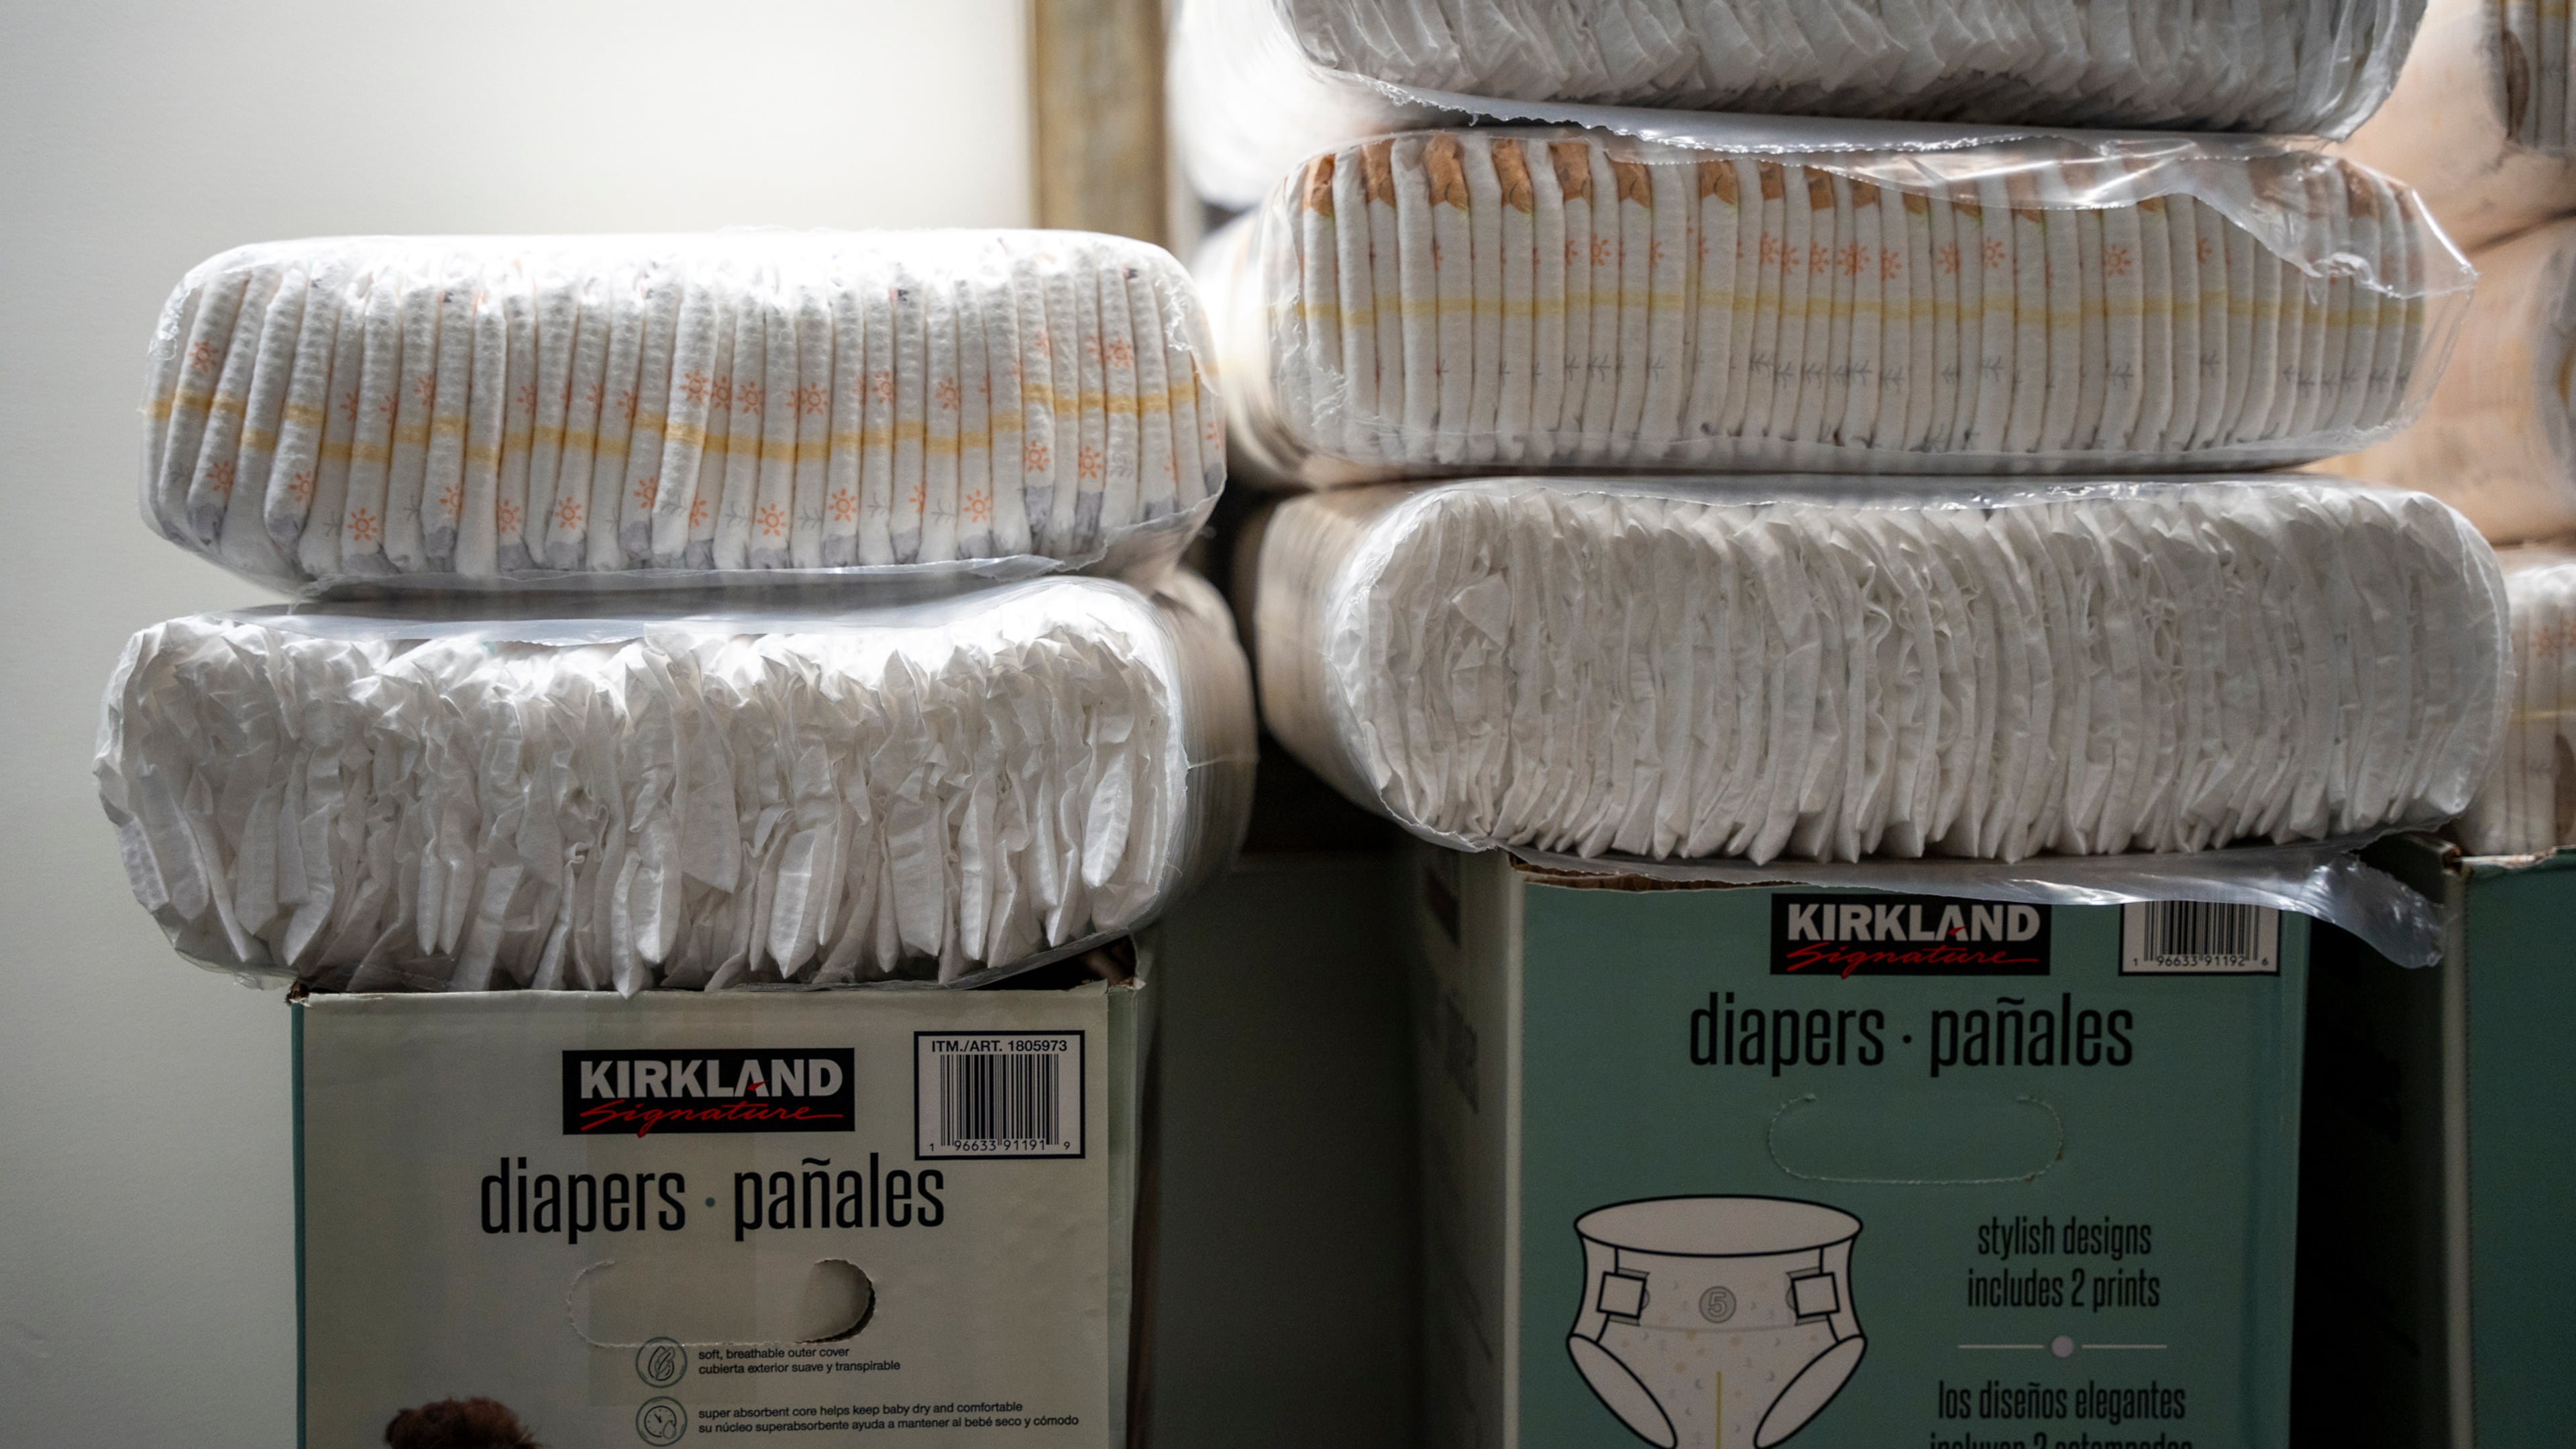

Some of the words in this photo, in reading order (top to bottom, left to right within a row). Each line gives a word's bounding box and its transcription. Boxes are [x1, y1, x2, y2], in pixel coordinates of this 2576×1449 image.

[1788, 904, 2041, 941] KIRKLAND
[1787, 942, 2038, 977] Signature
[2157, 955, 2198, 966] 96633
[2204, 955, 2245, 966] 91192
[932, 1040, 1002, 1052] ITM./ART.
[1008, 1040, 1067, 1051] 1805973
[1690, 992, 1884, 1077] diapers
[1931, 993, 2133, 1077] pañales
[582, 1059, 842, 1098] KIRKLAND
[580, 1099, 843, 1137] Signature
[955, 1140, 996, 1150] 96633
[1004, 1140, 1044, 1150] 91191
[482, 1157, 685, 1244] diapers
[735, 1152, 944, 1242] pañales
[1978, 1216, 2054, 1260] stylish
[2063, 1216, 2151, 1261] designs
[1707, 1291, 1727, 1317] 5
[1968, 1268, 2063, 1307] includes
[2072, 1268, 2085, 1307] 2
[2093, 1268, 2160, 1313] prints
[699, 1349, 722, 1360] soft,
[727, 1348, 784, 1358] breathable
[788, 1348, 816, 1357] outer
[820, 1348, 849, 1356] cover
[699, 1364, 745, 1374] cubierta
[747, 1363, 789, 1373] exterior
[792, 1364, 823, 1372] suave
[826, 1364, 833, 1373] y
[835, 1360, 900, 1373] transpirable
[699, 1410, 731, 1420] super
[733, 1407, 789, 1417] absorbent
[792, 1408, 817, 1416] core
[820, 1406, 849, 1417] helps
[853, 1405, 879, 1416] keep
[883, 1404, 910, 1415] baby
[912, 1404, 930, 1415] dry
[933, 1403, 954, 1413] and
[957, 1402, 1022, 1413] comfortable
[1939, 1381, 1971, 1419] los
[1979, 1381, 2067, 1419] diseños
[2076, 1381, 2186, 1426] elegantes
[716, 1422, 753, 1432] núcleo
[755, 1421, 849, 1433] superabsorbente
[852, 1419, 885, 1432] ayuda
[898, 1419, 950, 1428] mantener
[953, 1417, 961, 1427] al
[965, 1417, 992, 1427] bebé
[996, 1418, 1022, 1426] seco
[1024, 1419, 1030, 1428] y
[1034, 1415, 1079, 1426] cómodo
